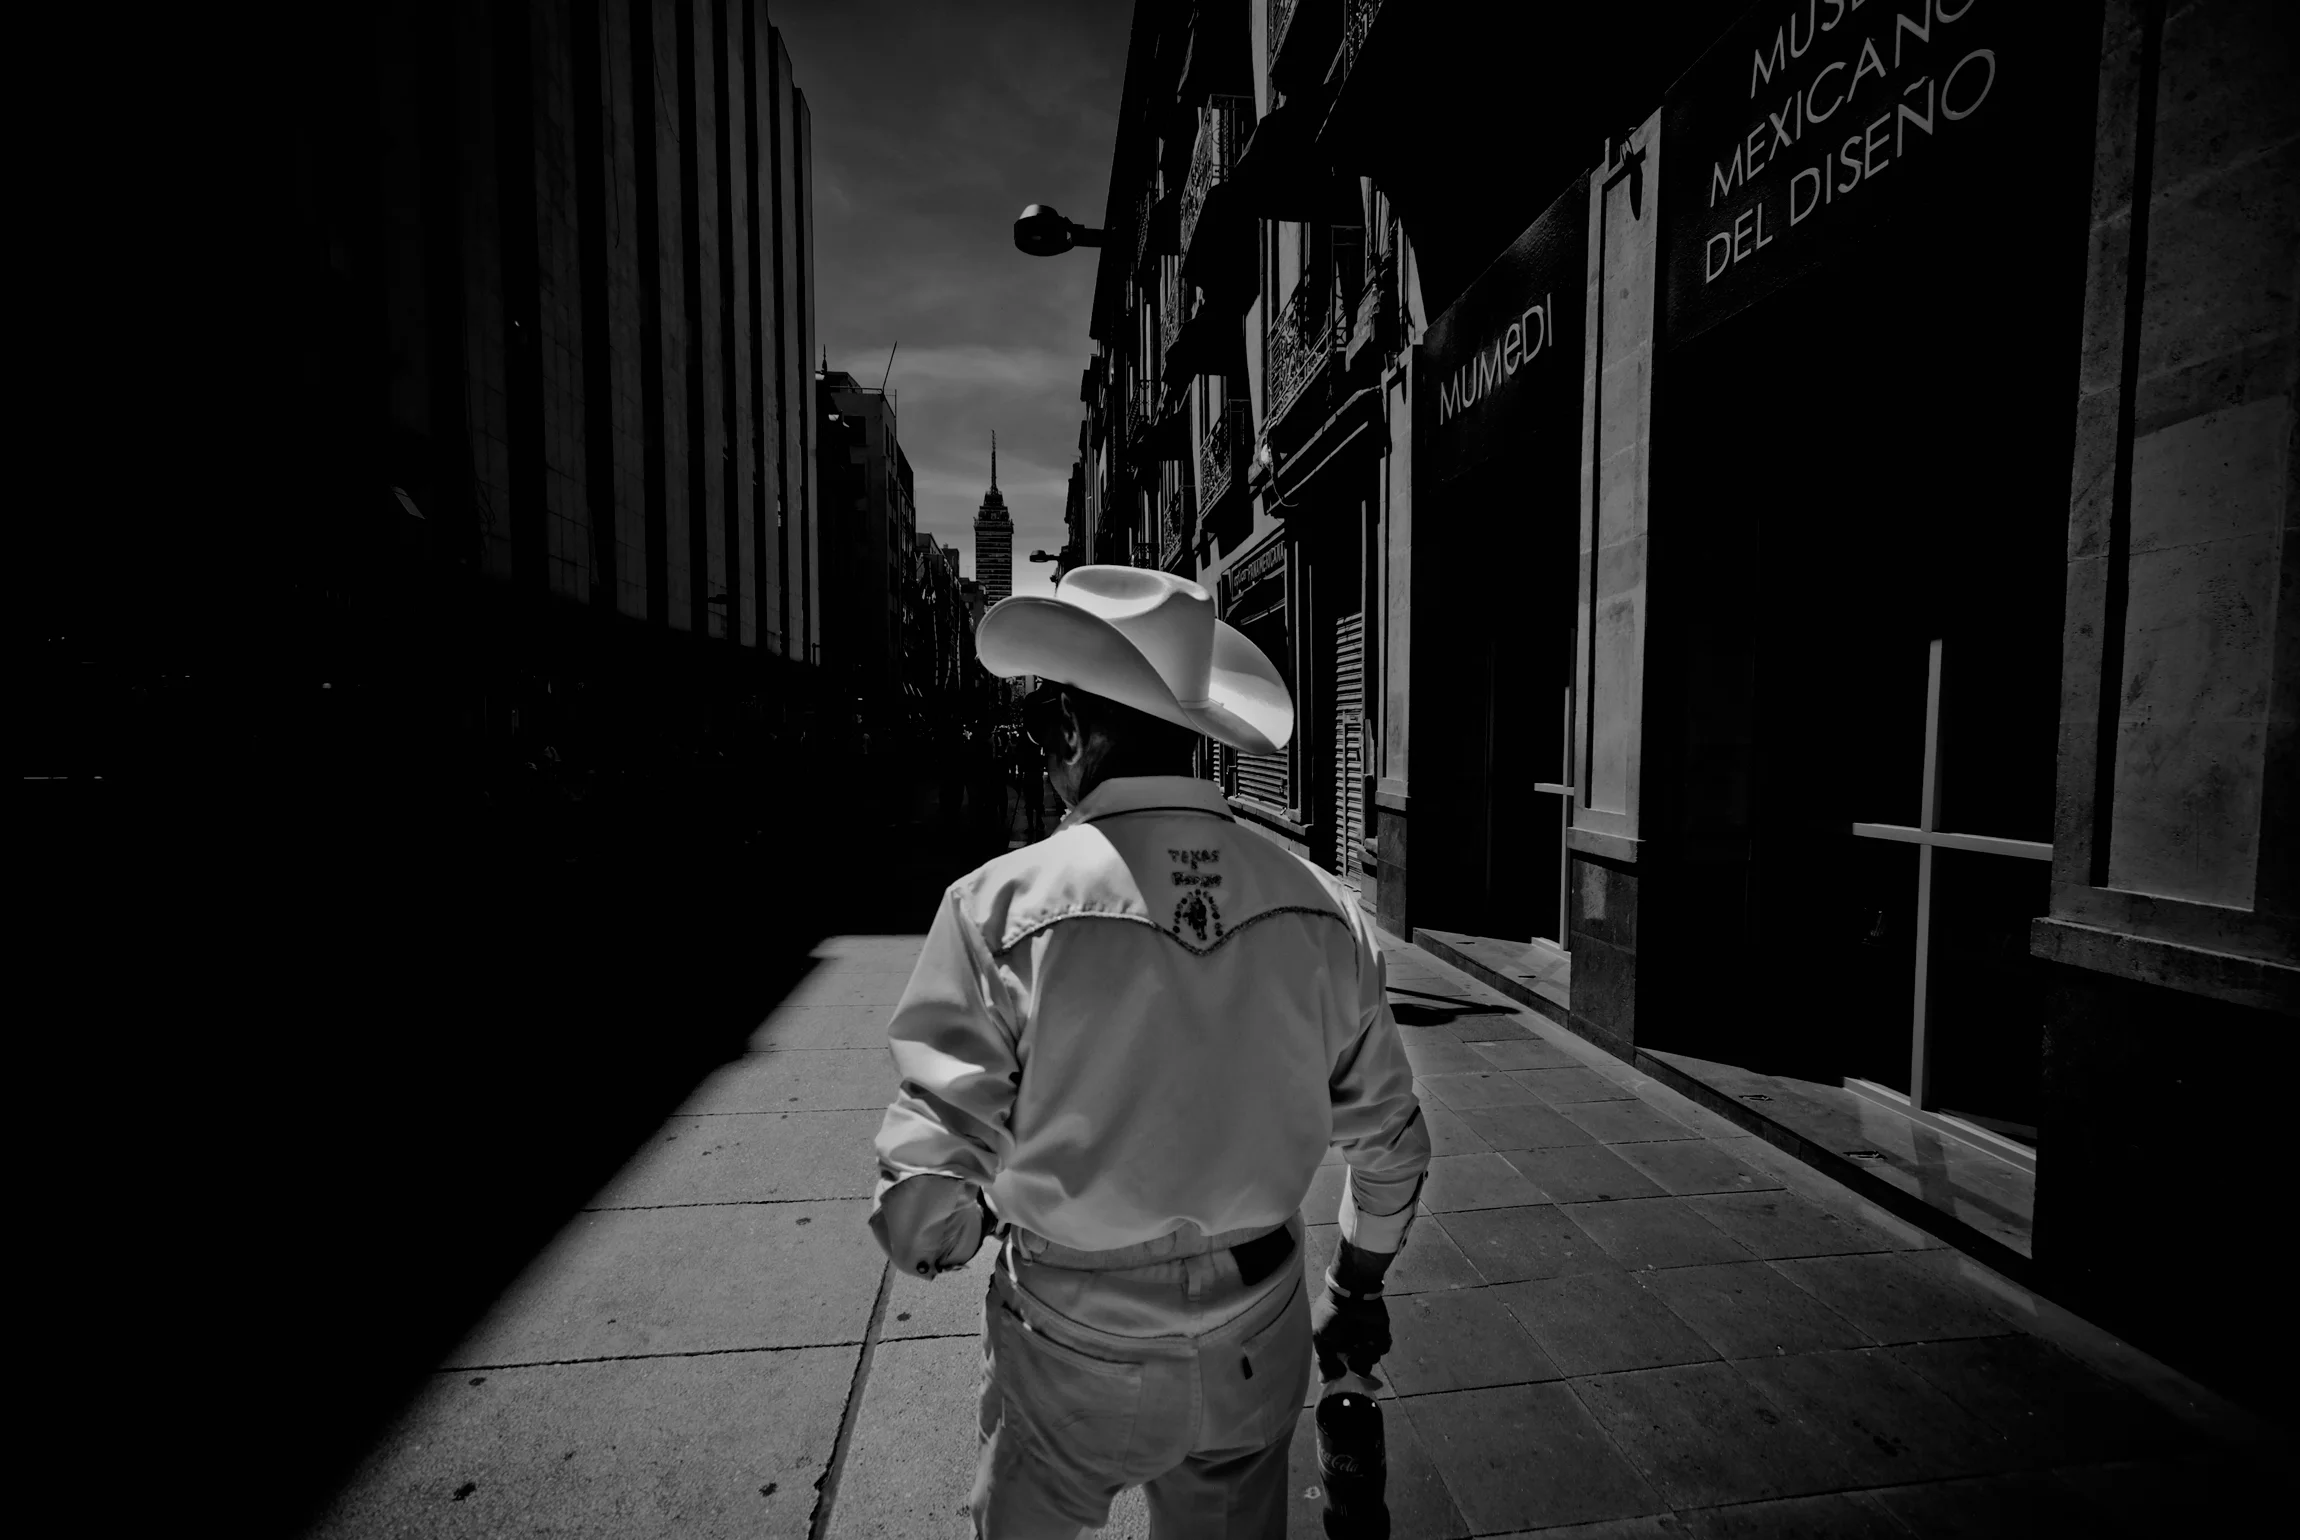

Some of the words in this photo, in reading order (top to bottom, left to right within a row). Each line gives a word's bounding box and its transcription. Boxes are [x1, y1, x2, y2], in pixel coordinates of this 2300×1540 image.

[1750, 0, 1866, 100] MUS
[1705, 202, 1773, 285] DEL
[1789, 48, 1997, 227] DISEÑO
[1167, 849, 1220, 863] TEXAS
